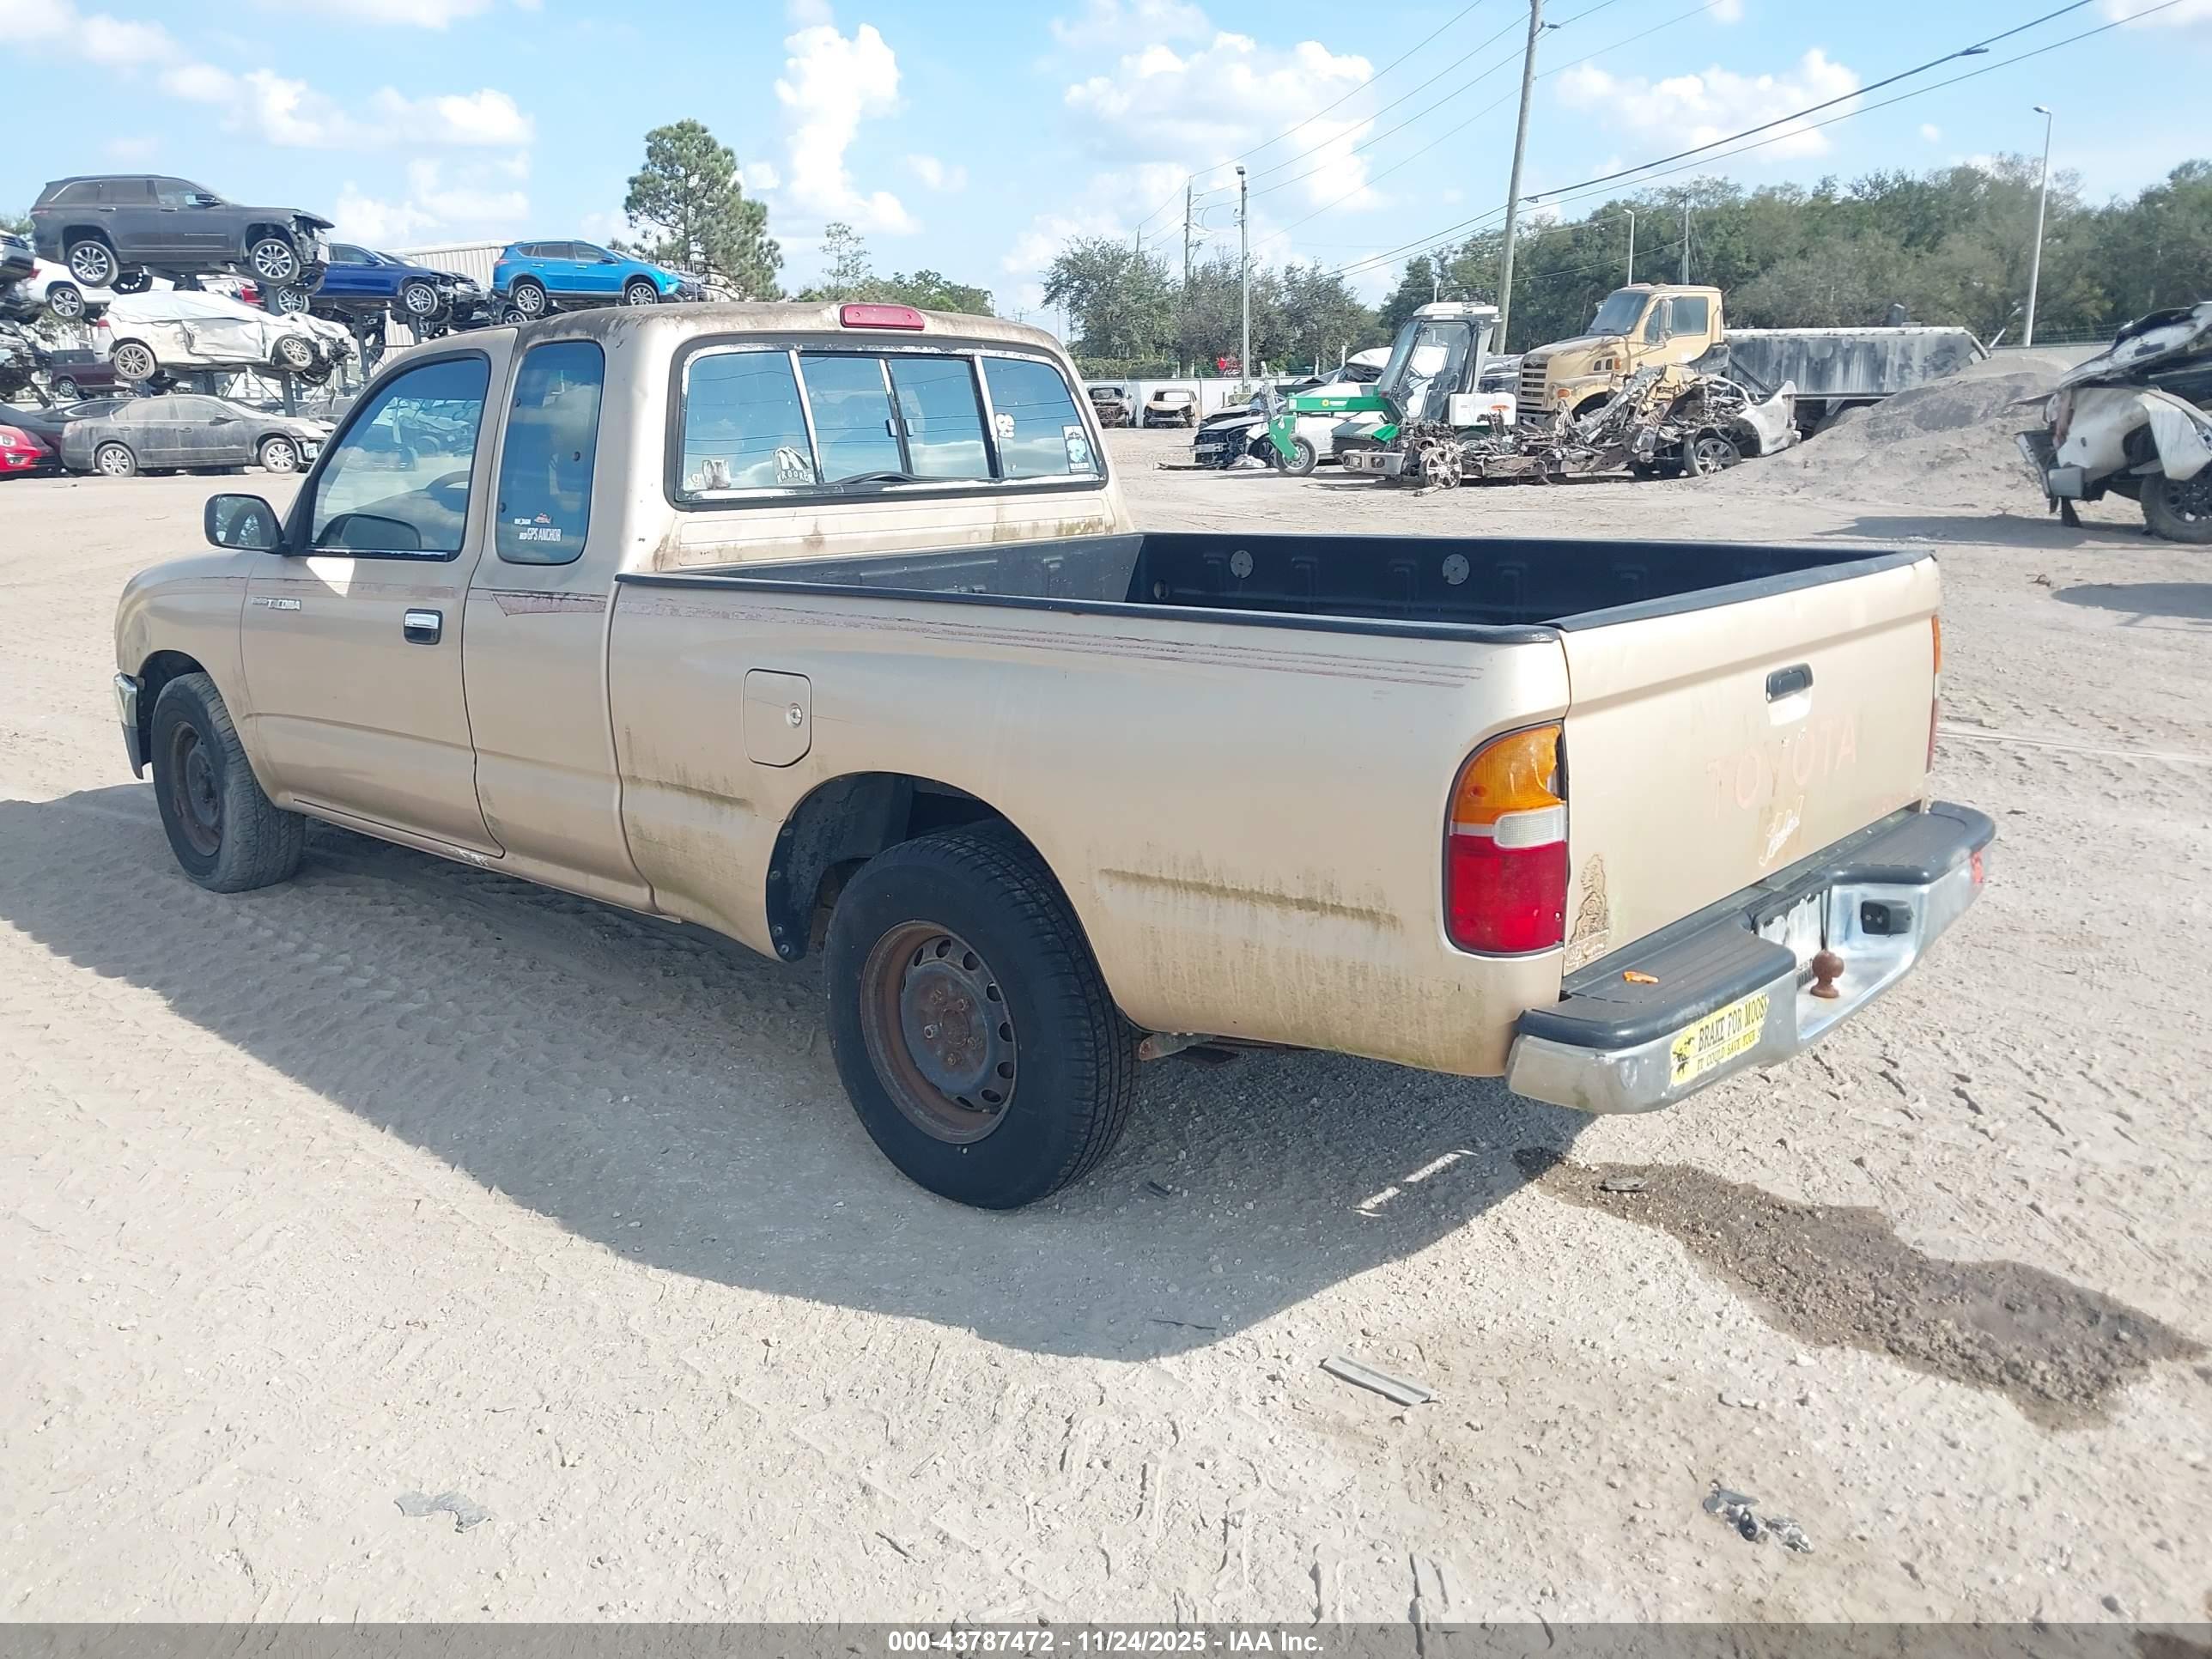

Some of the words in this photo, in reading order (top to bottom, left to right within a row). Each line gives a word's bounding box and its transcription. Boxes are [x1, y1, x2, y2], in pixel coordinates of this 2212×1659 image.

[538, 528, 562, 542] ANCHOR
[1705, 714, 1857, 818] TOYOTA
[1698, 1017, 1725, 1053] BRAKE
[1727, 1007, 1742, 1037] FOR
[1697, 1058, 1705, 1072] IT
[1706, 1046, 1725, 1066] COULD
[1727, 1038, 1741, 1056] SAVE
